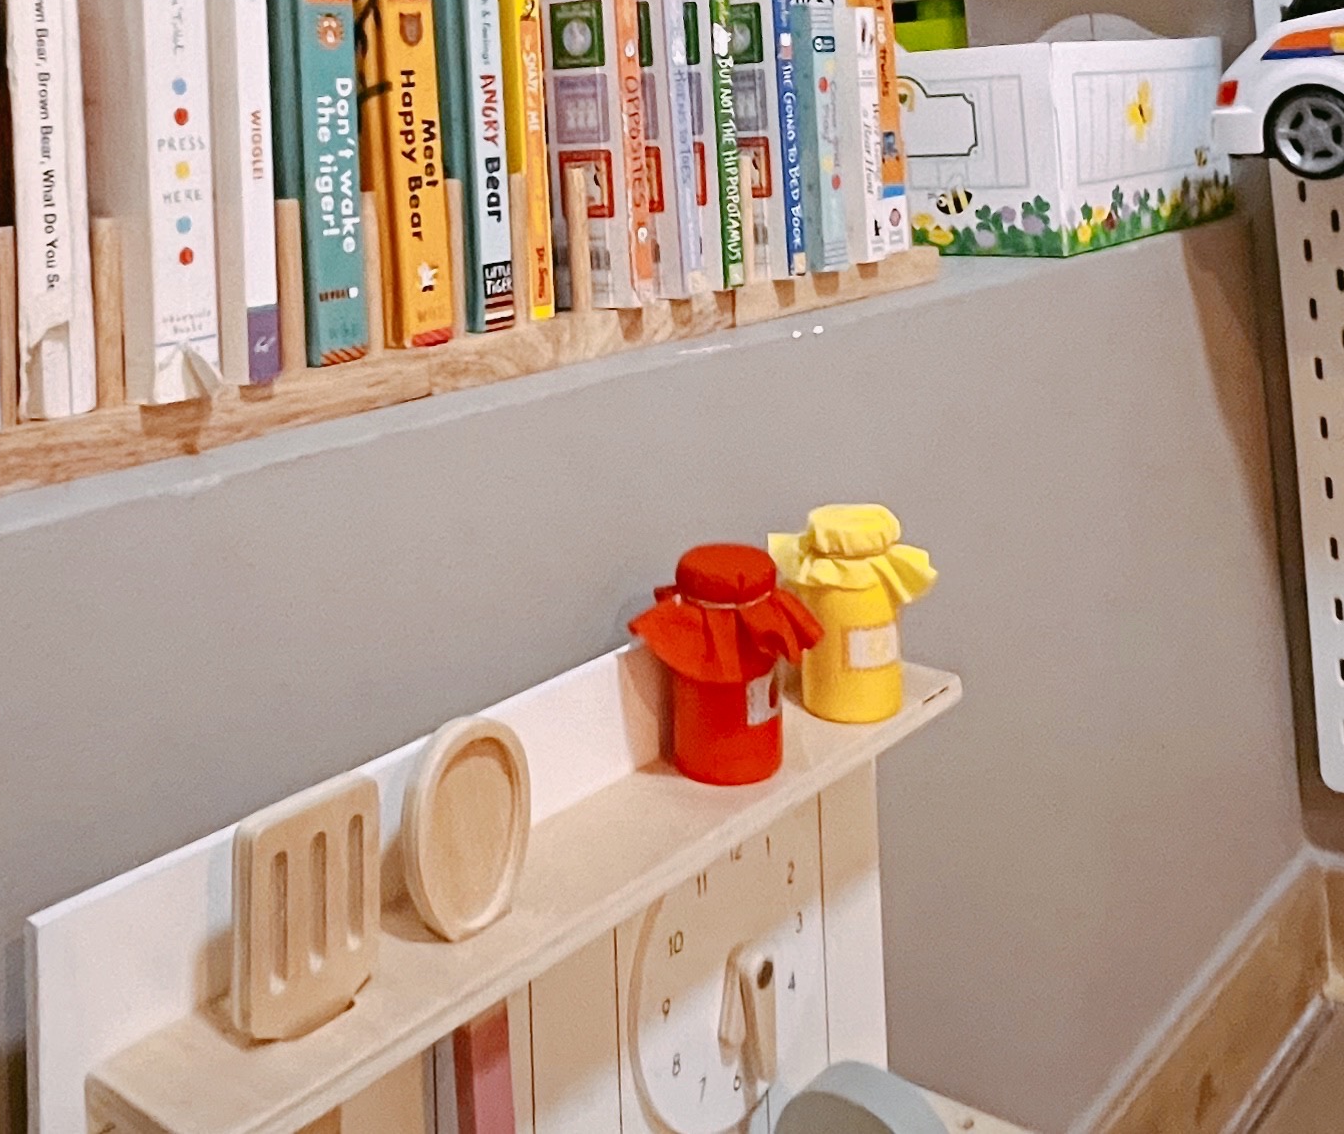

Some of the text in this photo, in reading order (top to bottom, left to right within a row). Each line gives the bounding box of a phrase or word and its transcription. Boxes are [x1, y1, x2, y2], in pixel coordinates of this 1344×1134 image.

[34, 28, 49, 67] Bear,
[36, 72, 51, 122] Brown
[479, 74, 499, 149] ANGRY
[39, 124, 54, 165] Bear,
[156, 136, 207, 153] PRESS
[396, 68, 426, 242] Happy Bear
[421, 118, 439, 188] Meet
[716, 54, 744, 261] BUT NOT THE HIPPOPOTAMUS
[314, 94, 341, 237] the tiger!
[334, 76, 360, 254] Don't wake
[42, 169, 56, 209] What
[162, 187, 205, 205] HERE
[484, 155, 503, 224] Bear
[43, 214, 57, 235] Do
[45, 238, 59, 270] You
[696, 871, 708, 897] 11
[787, 860, 796, 885] 2
[795, 911, 804, 934] 3
[668, 930, 684, 957] 10
[787, 970, 796, 992] 4
[661, 997, 671, 1023] 9
[671, 1052, 681, 1078] 8
[699, 1075, 708, 1104] 7
